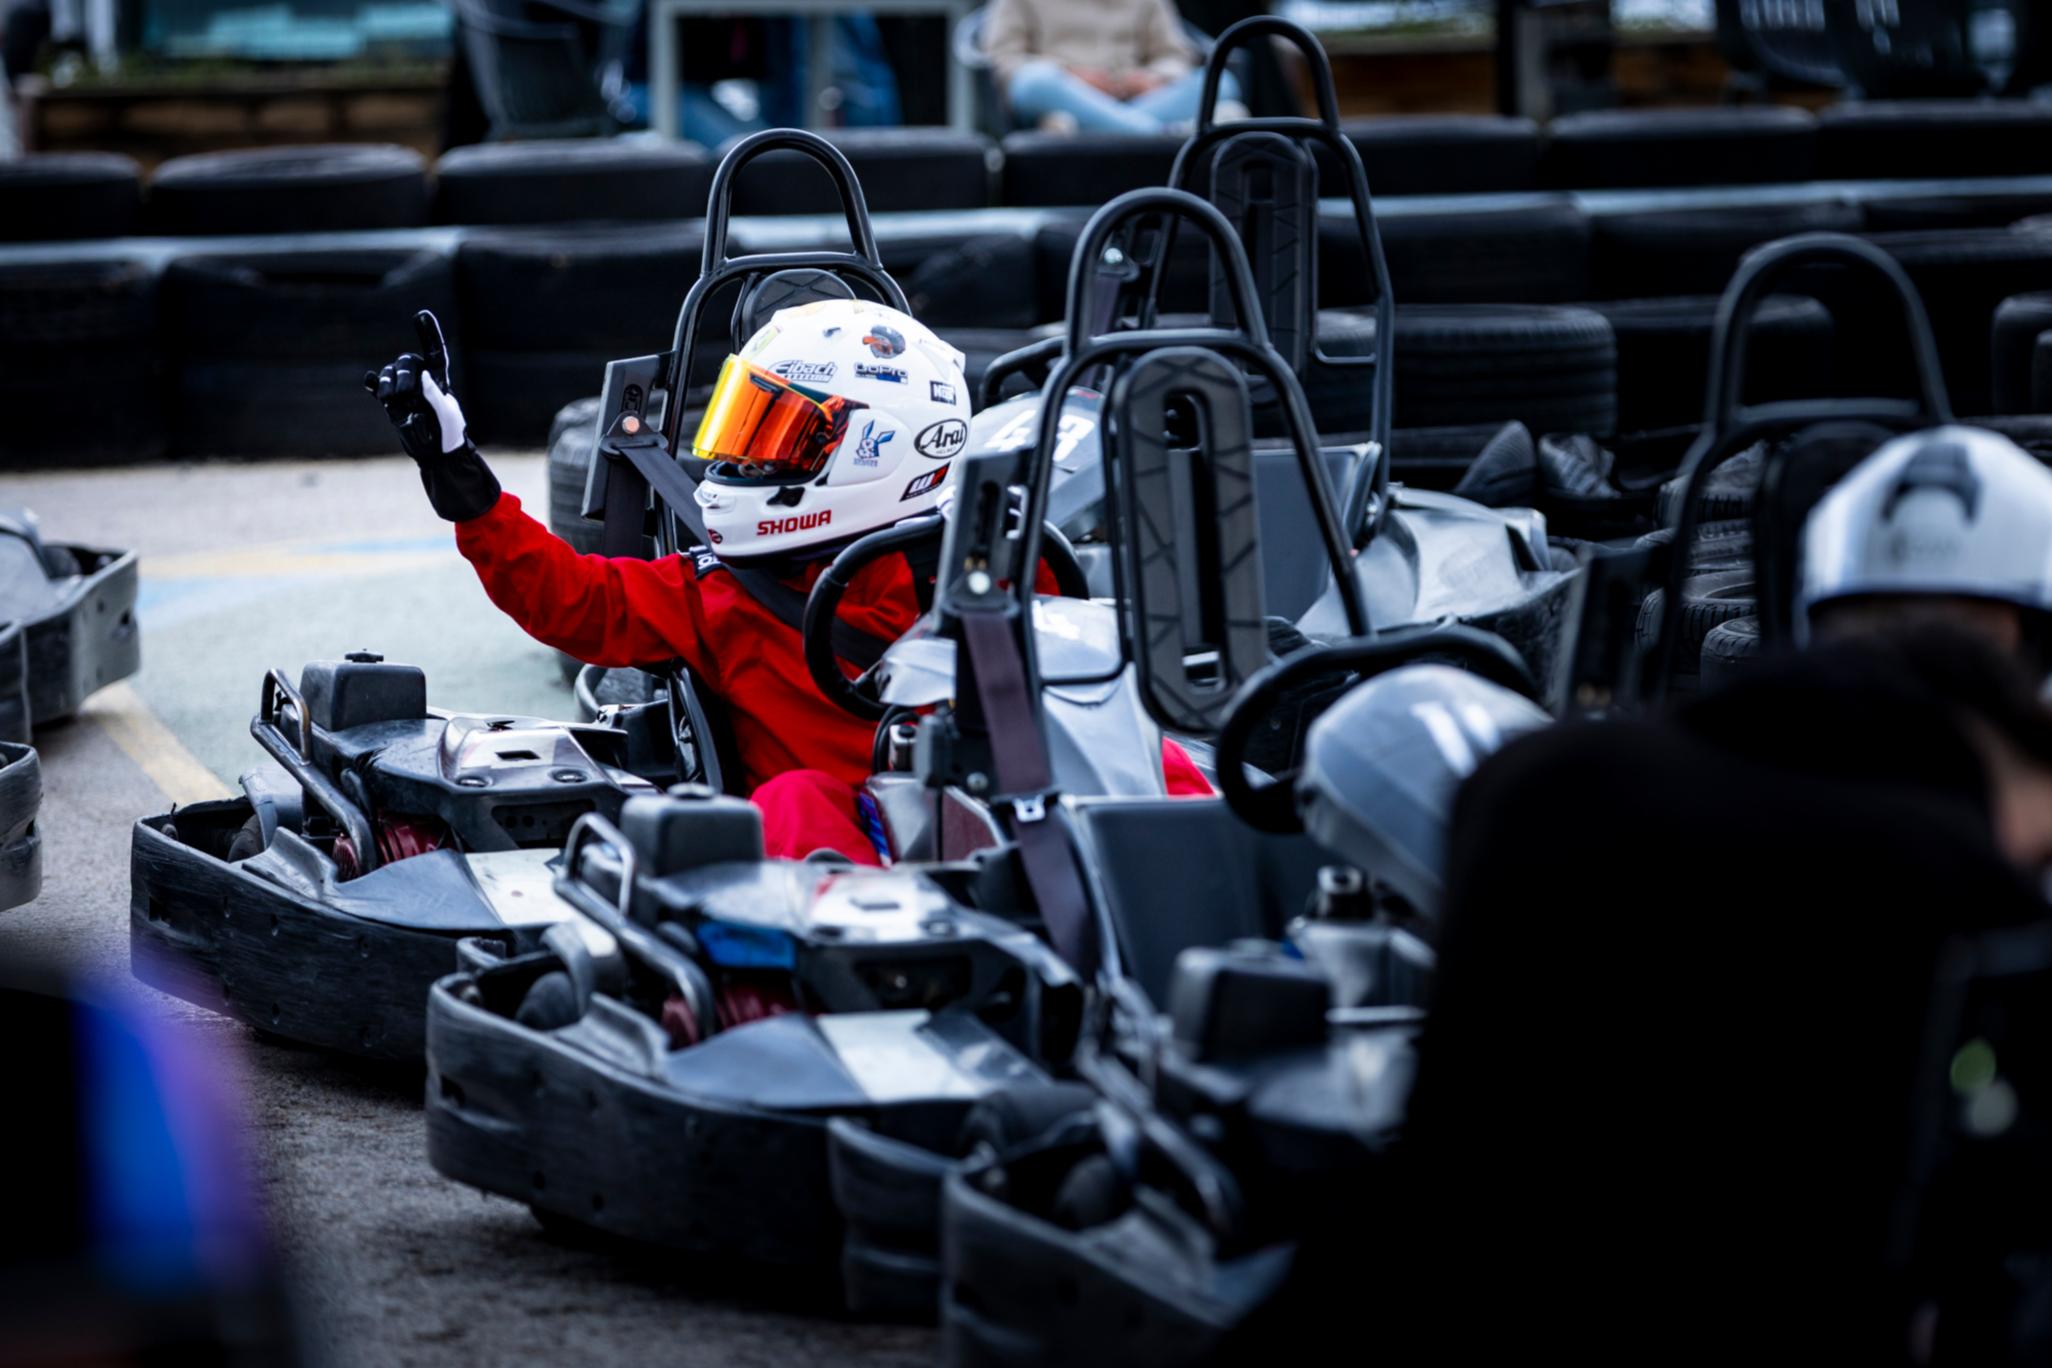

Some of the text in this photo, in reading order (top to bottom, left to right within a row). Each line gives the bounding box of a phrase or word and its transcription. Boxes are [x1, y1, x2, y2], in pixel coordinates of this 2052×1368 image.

[769, 360, 837, 376] Eibach
[854, 362, 909, 377] GoPro
[919, 422, 964, 449] Arai
[757, 509, 832, 536] SHOWA
